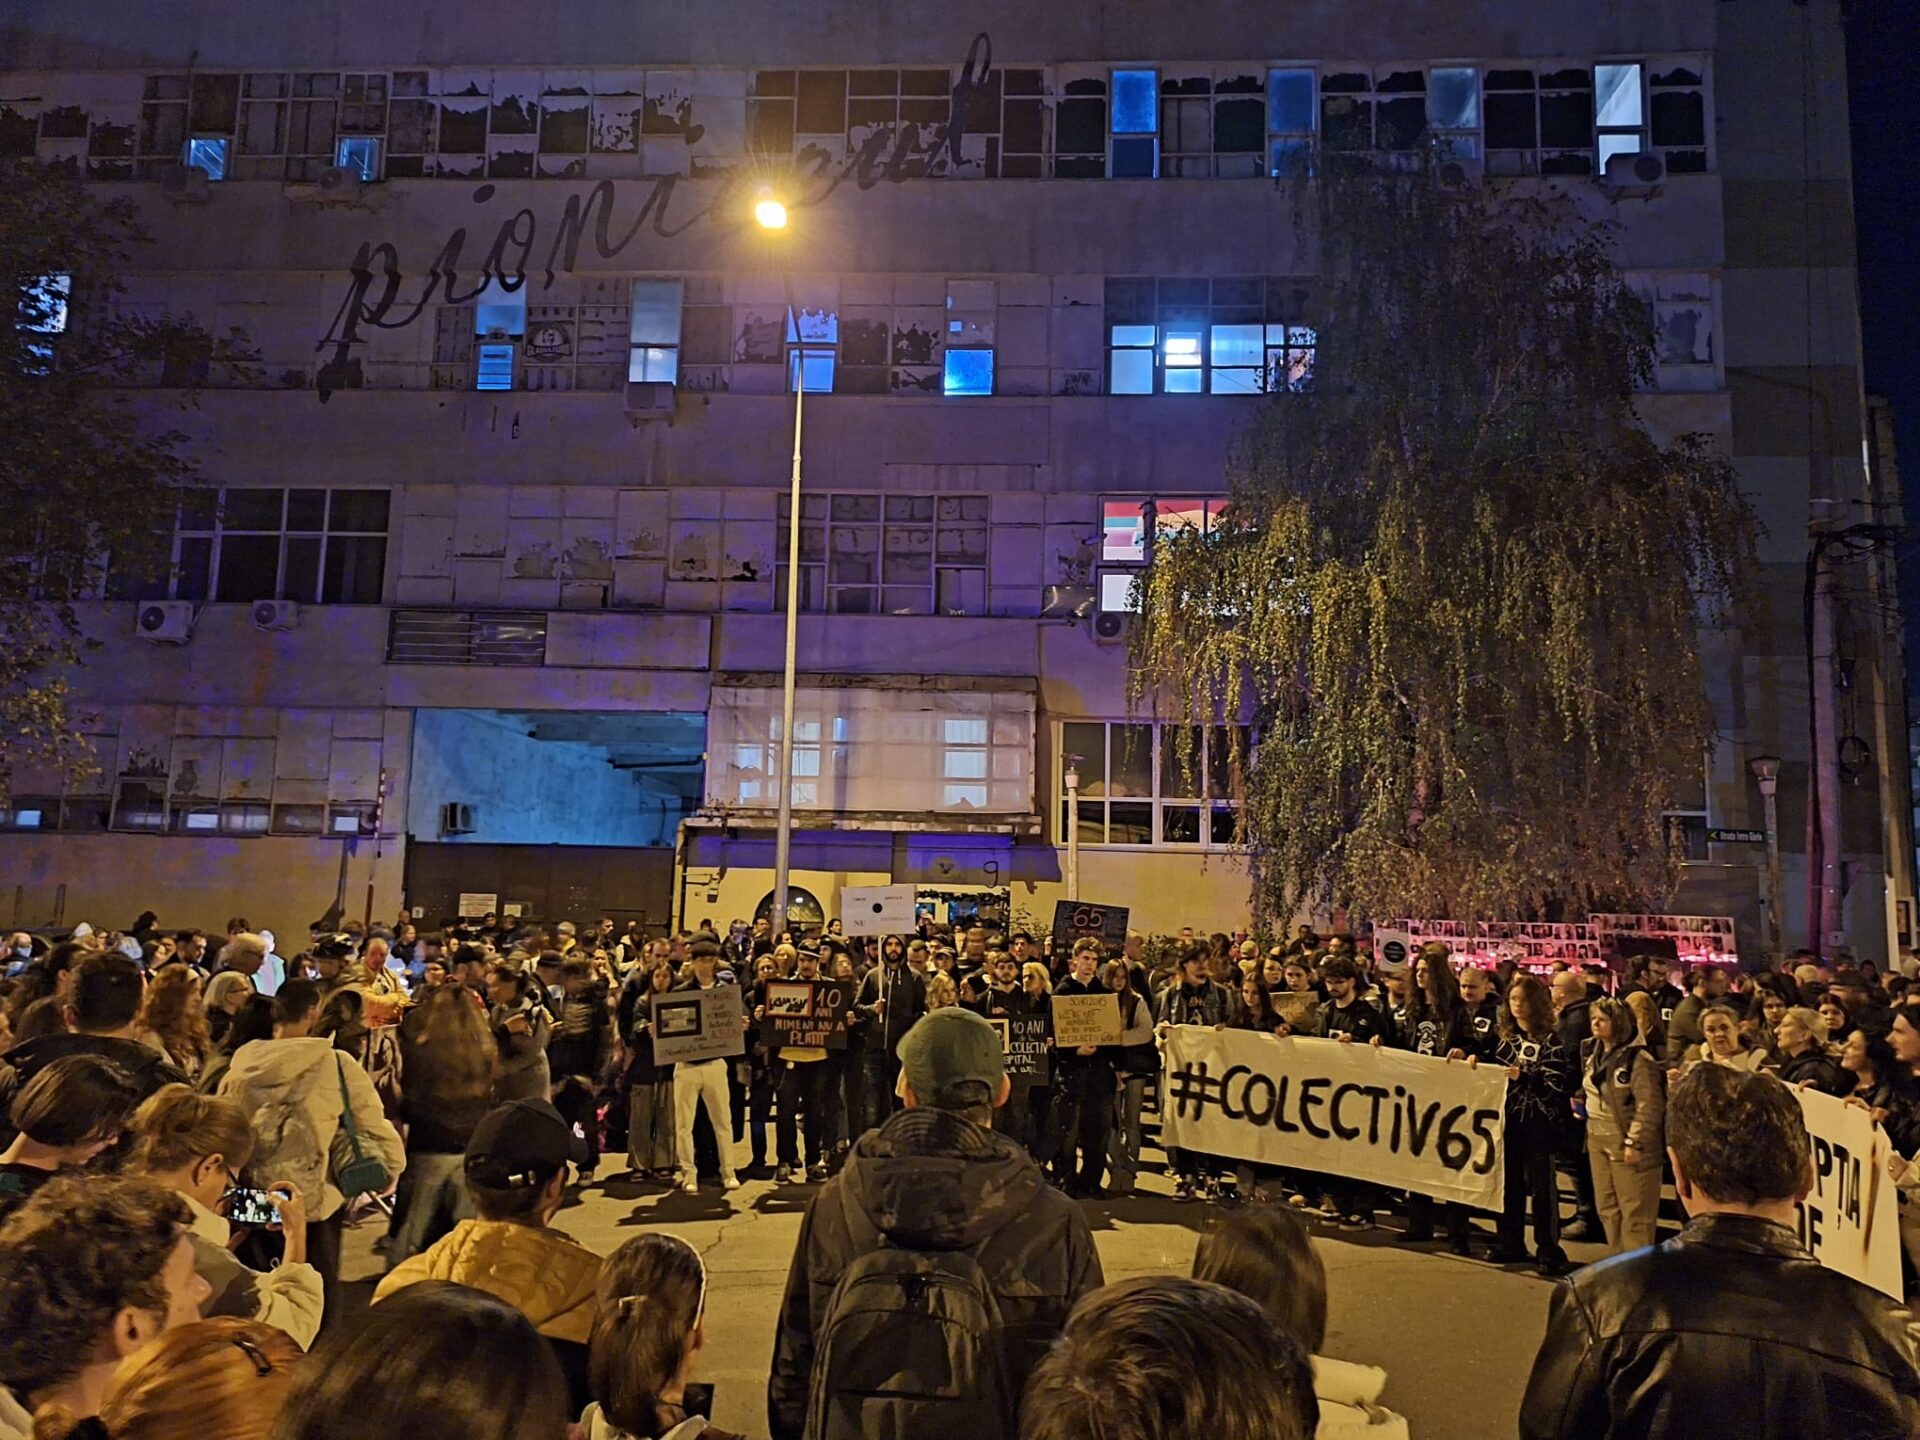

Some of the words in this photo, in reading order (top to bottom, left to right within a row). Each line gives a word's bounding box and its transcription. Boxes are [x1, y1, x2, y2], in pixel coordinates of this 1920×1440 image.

[1073, 906, 1107, 928] 65
[816, 988, 842, 1009] 10
[815, 1007, 833, 1018] ANI
[775, 1018, 814, 1031] NIMENI
[818, 1020, 833, 1031] NU
[836, 1020, 845, 1032] A
[1012, 1020, 1025, 1034] 10
[1026, 1018, 1045, 1034] ANI
